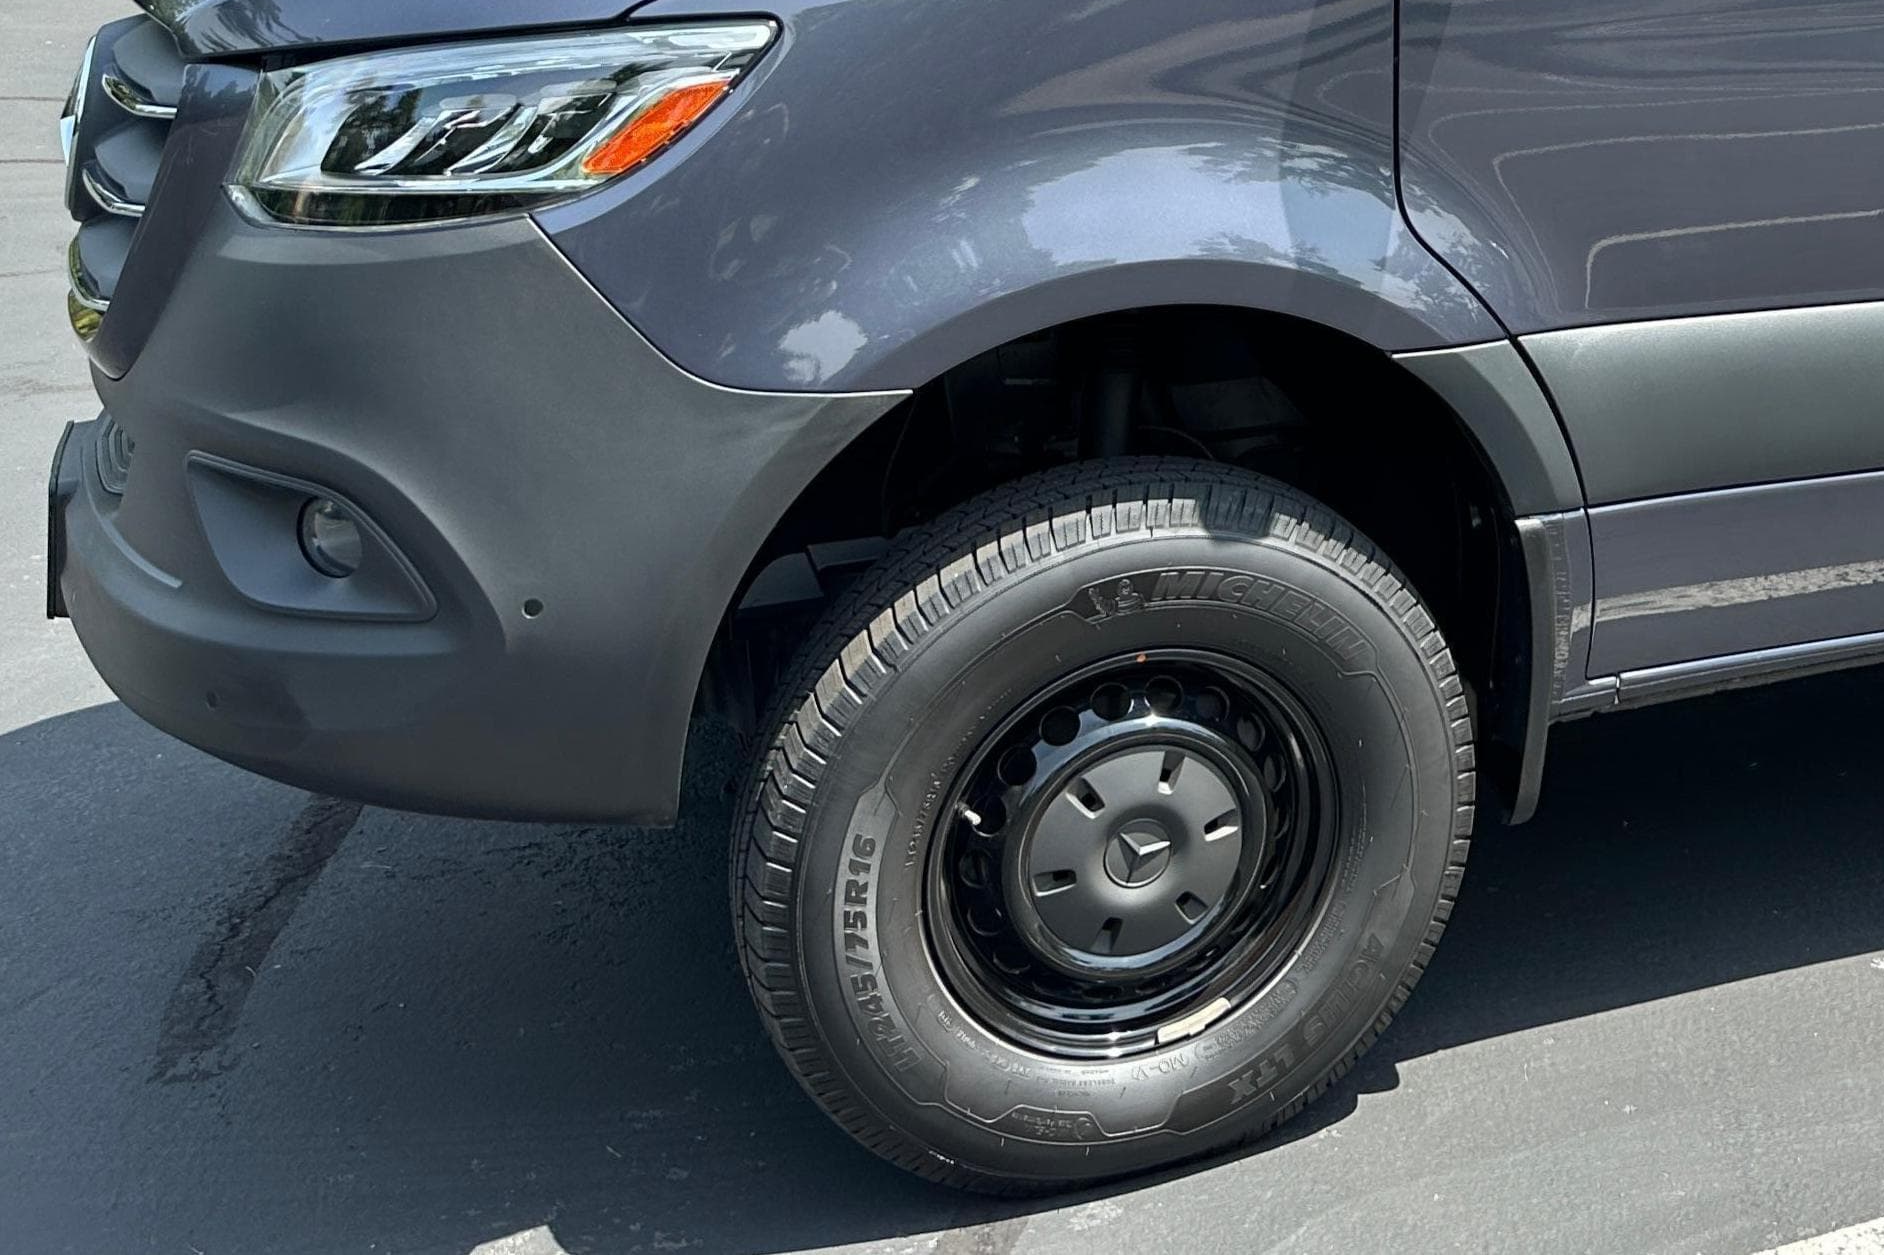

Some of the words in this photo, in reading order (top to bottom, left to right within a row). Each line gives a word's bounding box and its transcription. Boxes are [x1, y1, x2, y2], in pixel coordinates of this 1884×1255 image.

[1151, 571, 1366, 662] MICHELIN
[843, 833, 921, 1072] LT245/75R16
[1303, 933, 1385, 1044] AGILIS
[1228, 1044, 1295, 1104] LTX
